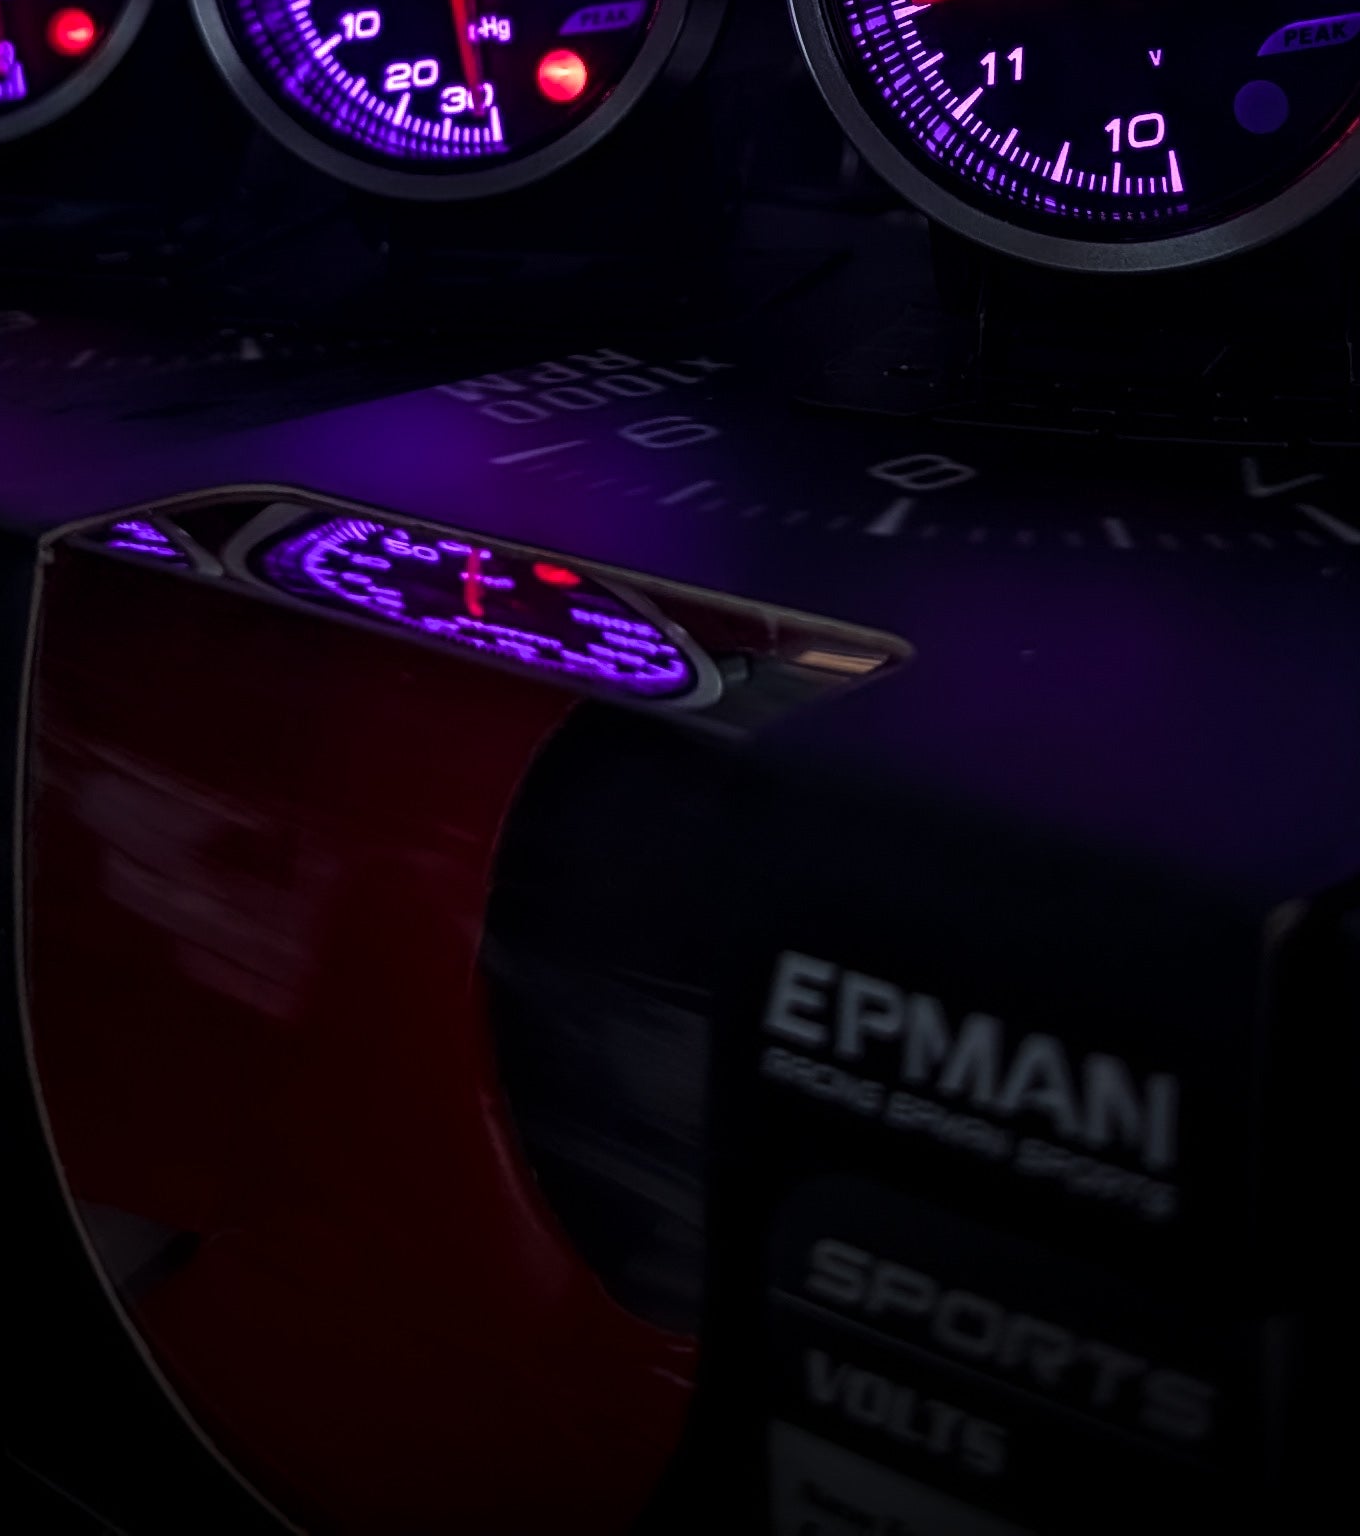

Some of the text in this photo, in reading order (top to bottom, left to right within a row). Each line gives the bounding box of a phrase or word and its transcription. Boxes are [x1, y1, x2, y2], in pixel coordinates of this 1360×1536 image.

[341, 9, 381, 40] 10
[580, 6, 629, 28] PEAK
[1283, 21, 1348, 47] PEAK
[385, 59, 439, 93] 20
[980, 46, 1025, 86] 11
[1104, 112, 1166, 153] 10
[760, 948, 1183, 1174] EPMAN
[802, 1236, 1220, 1442] SPORTS
[802, 1345, 1009, 1479] VOLTS
